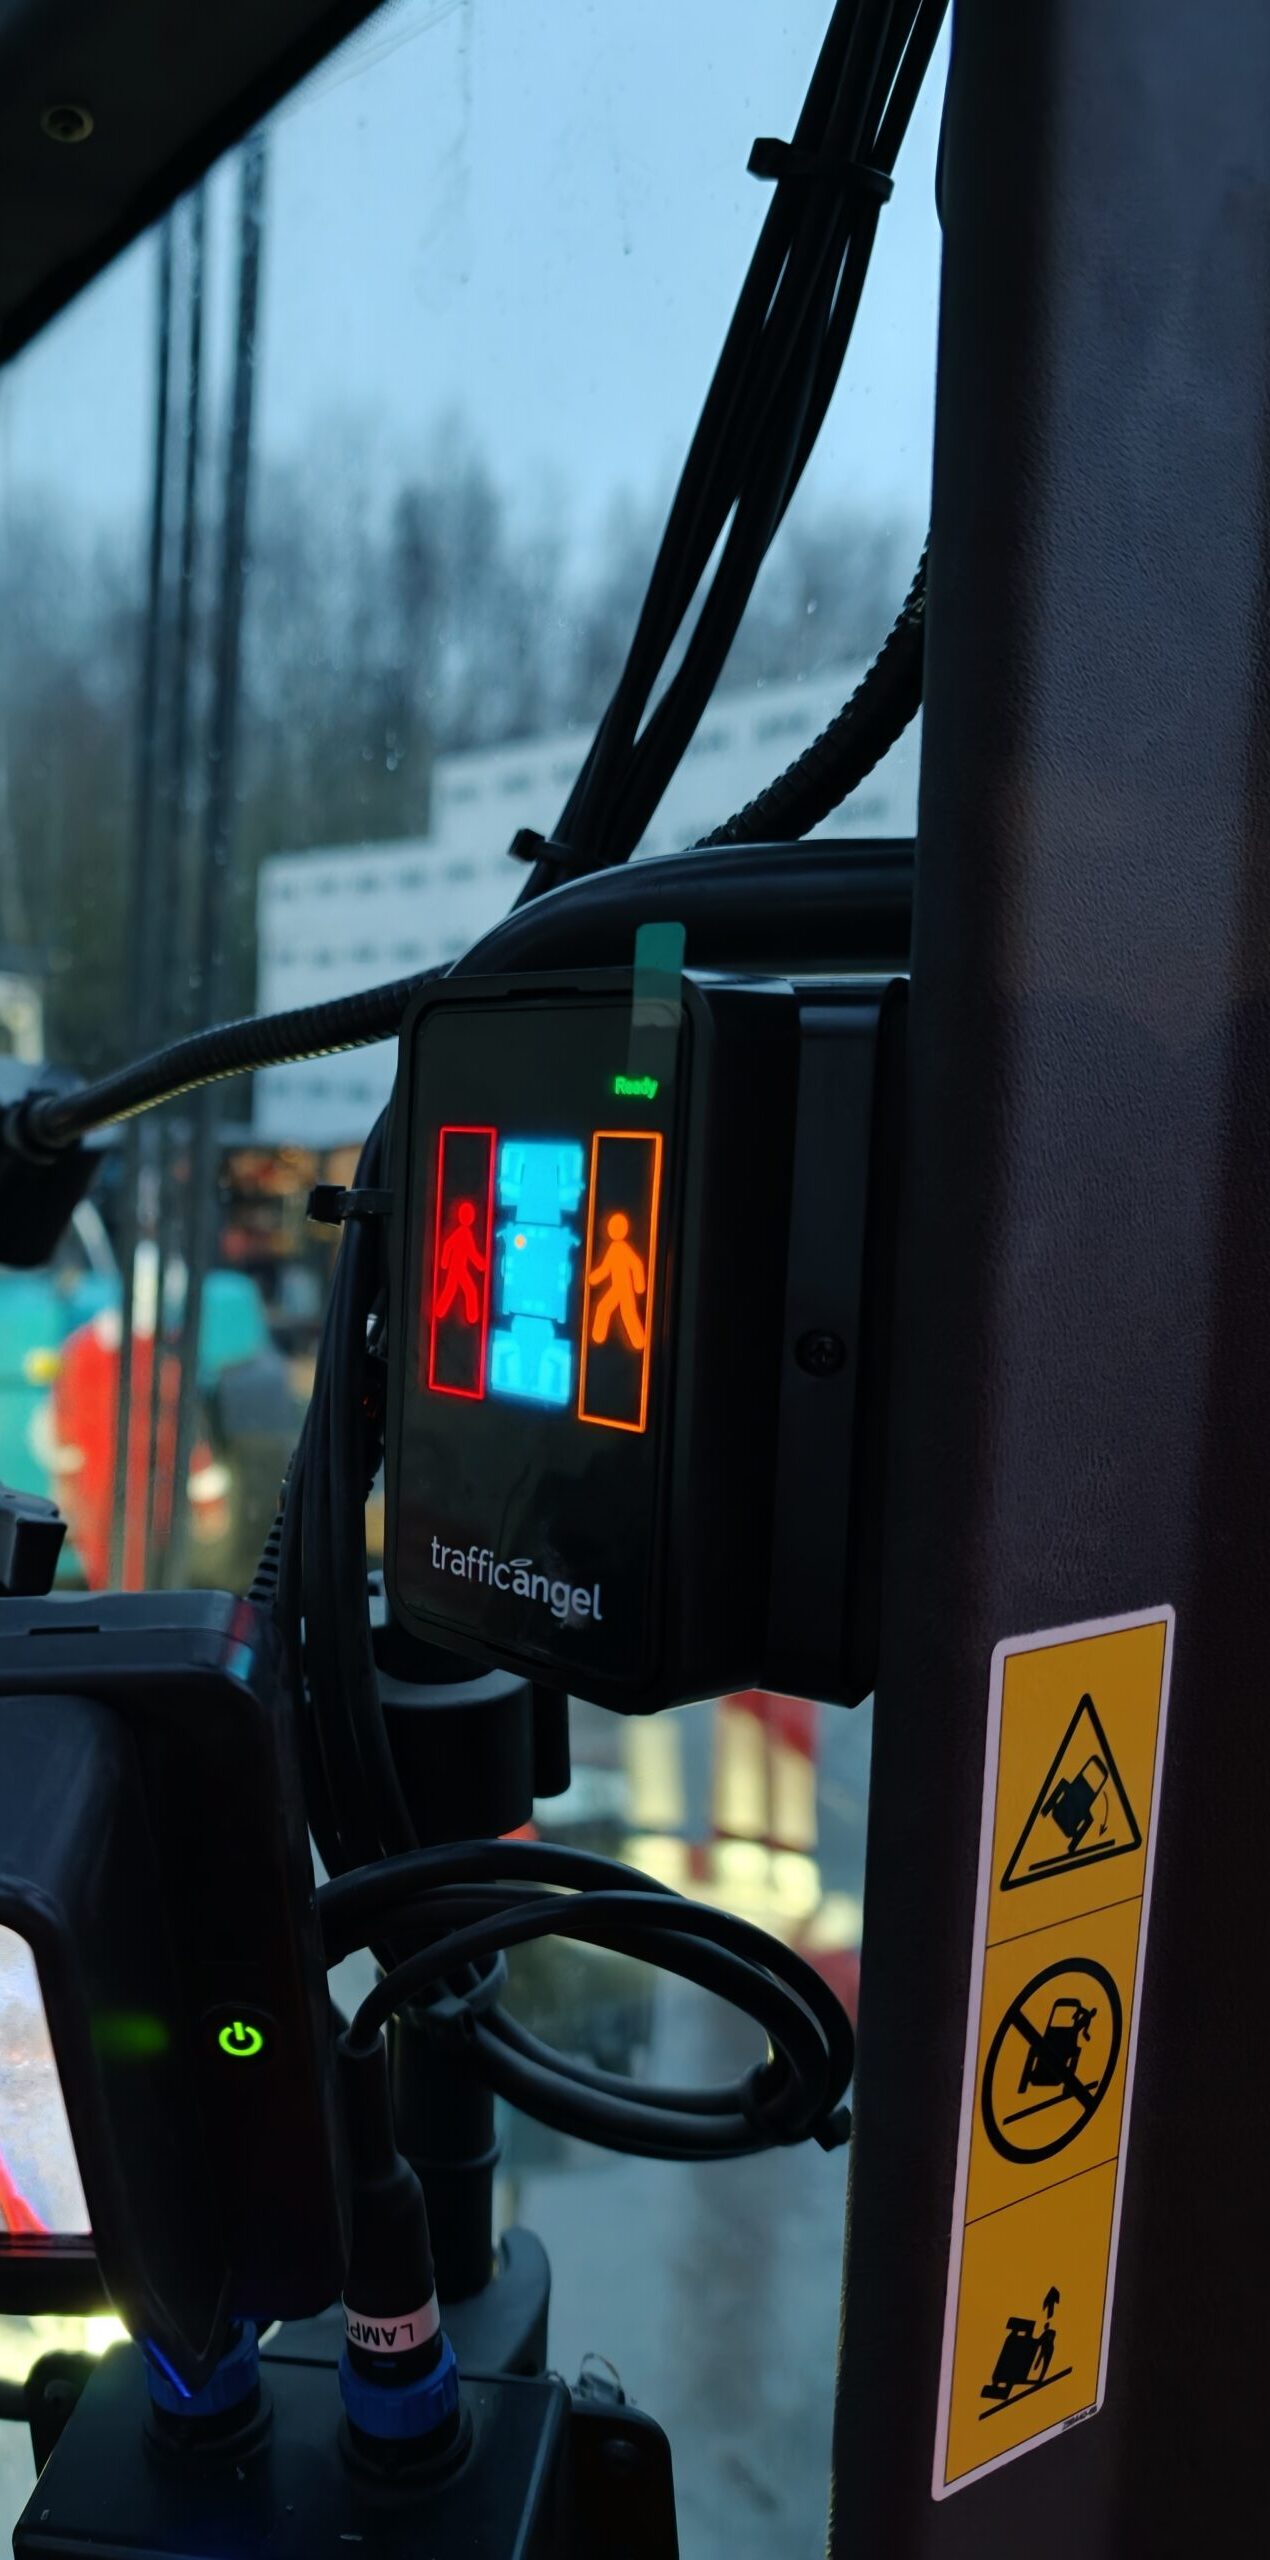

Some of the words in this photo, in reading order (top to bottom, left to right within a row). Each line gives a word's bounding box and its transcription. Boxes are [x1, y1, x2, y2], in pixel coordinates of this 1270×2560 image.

[615, 1076, 658, 1099] Ready
[431, 1535, 602, 1620] trafficangel
[346, 2321, 414, 2346] LAMP
